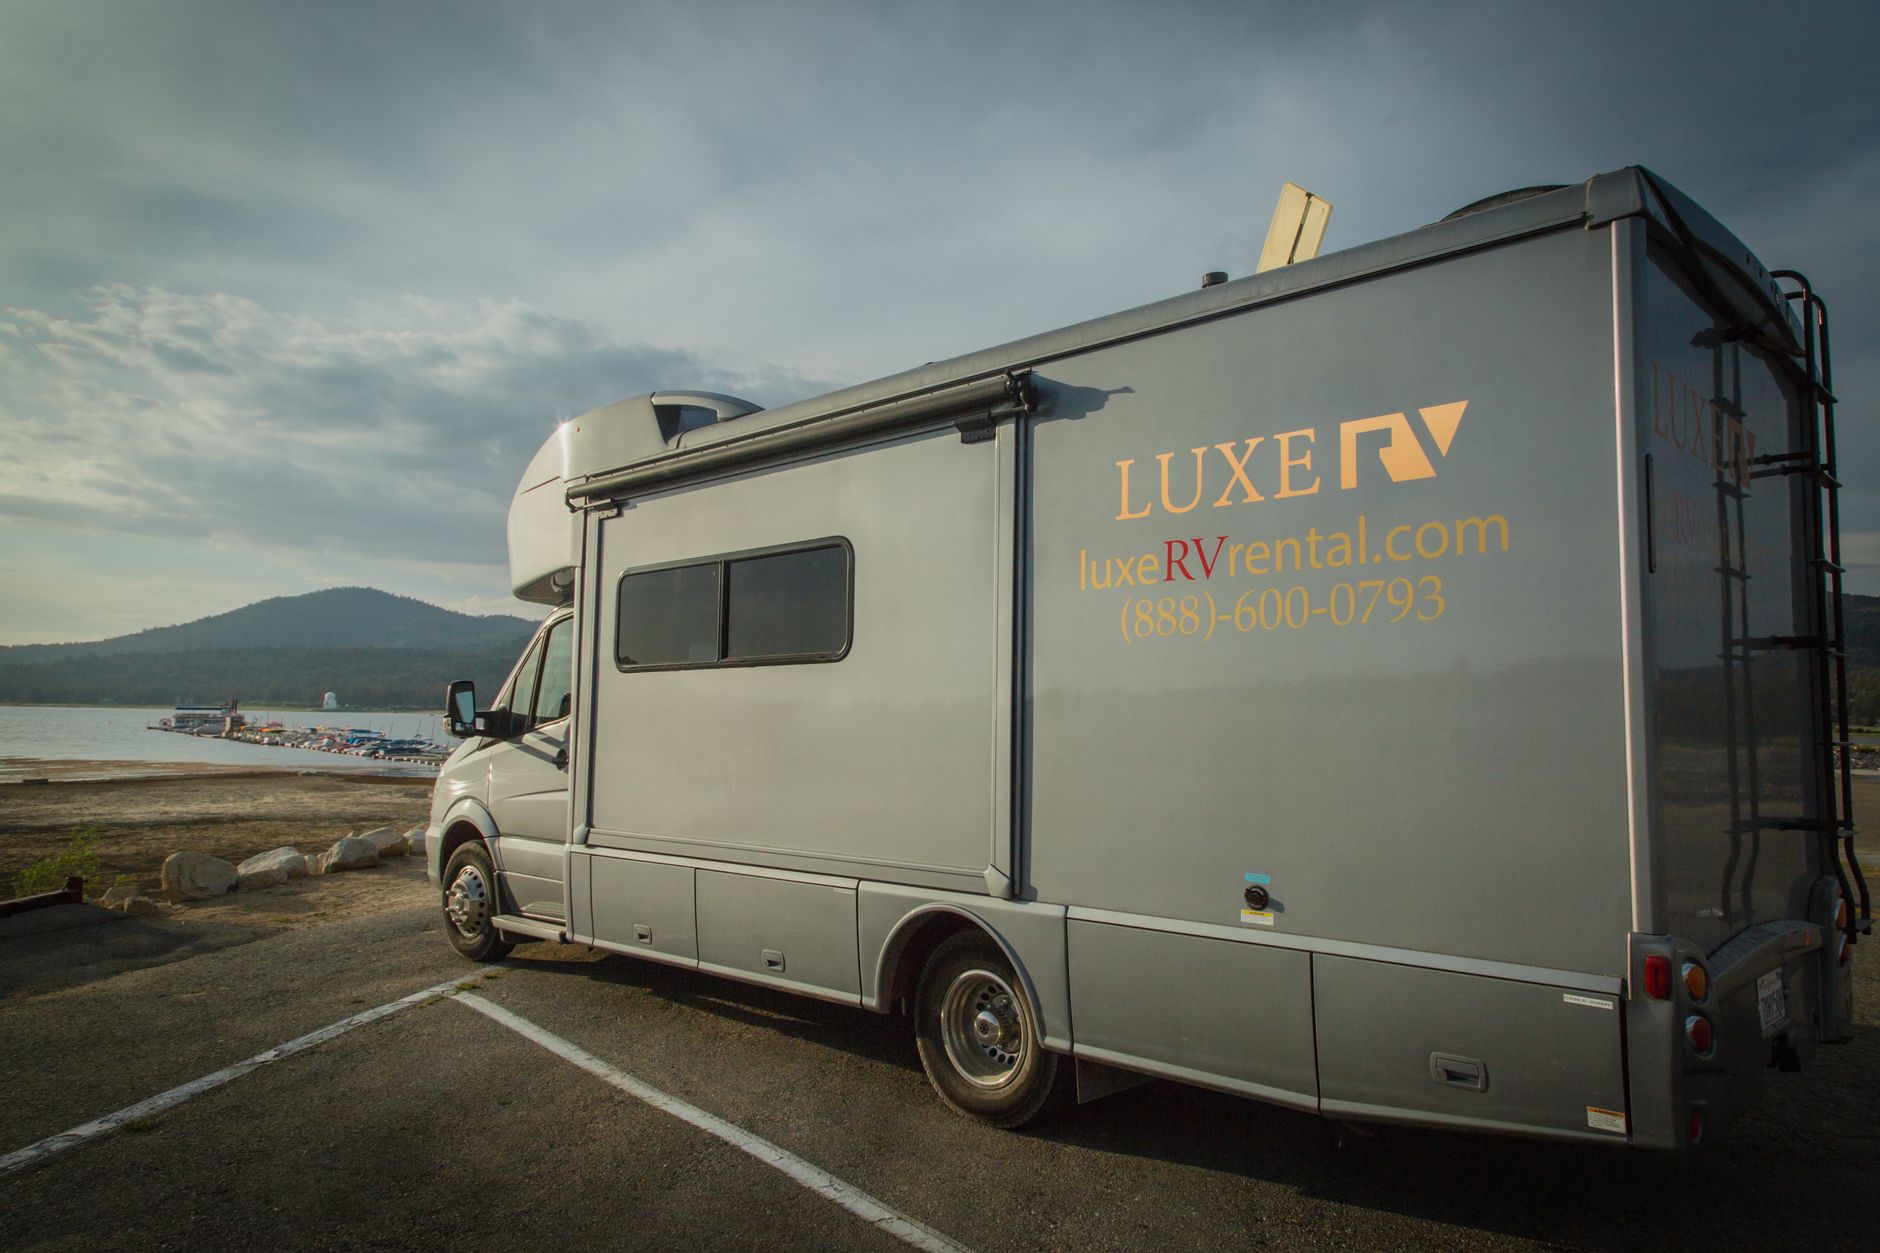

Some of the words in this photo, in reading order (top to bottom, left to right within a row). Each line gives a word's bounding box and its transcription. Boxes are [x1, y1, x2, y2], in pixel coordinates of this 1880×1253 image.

[1115, 427, 1321, 520] LUXE
[1079, 513, 1510, 591] luxeRVrental.com
[1120, 574, 1446, 645] (888)-600-0793
